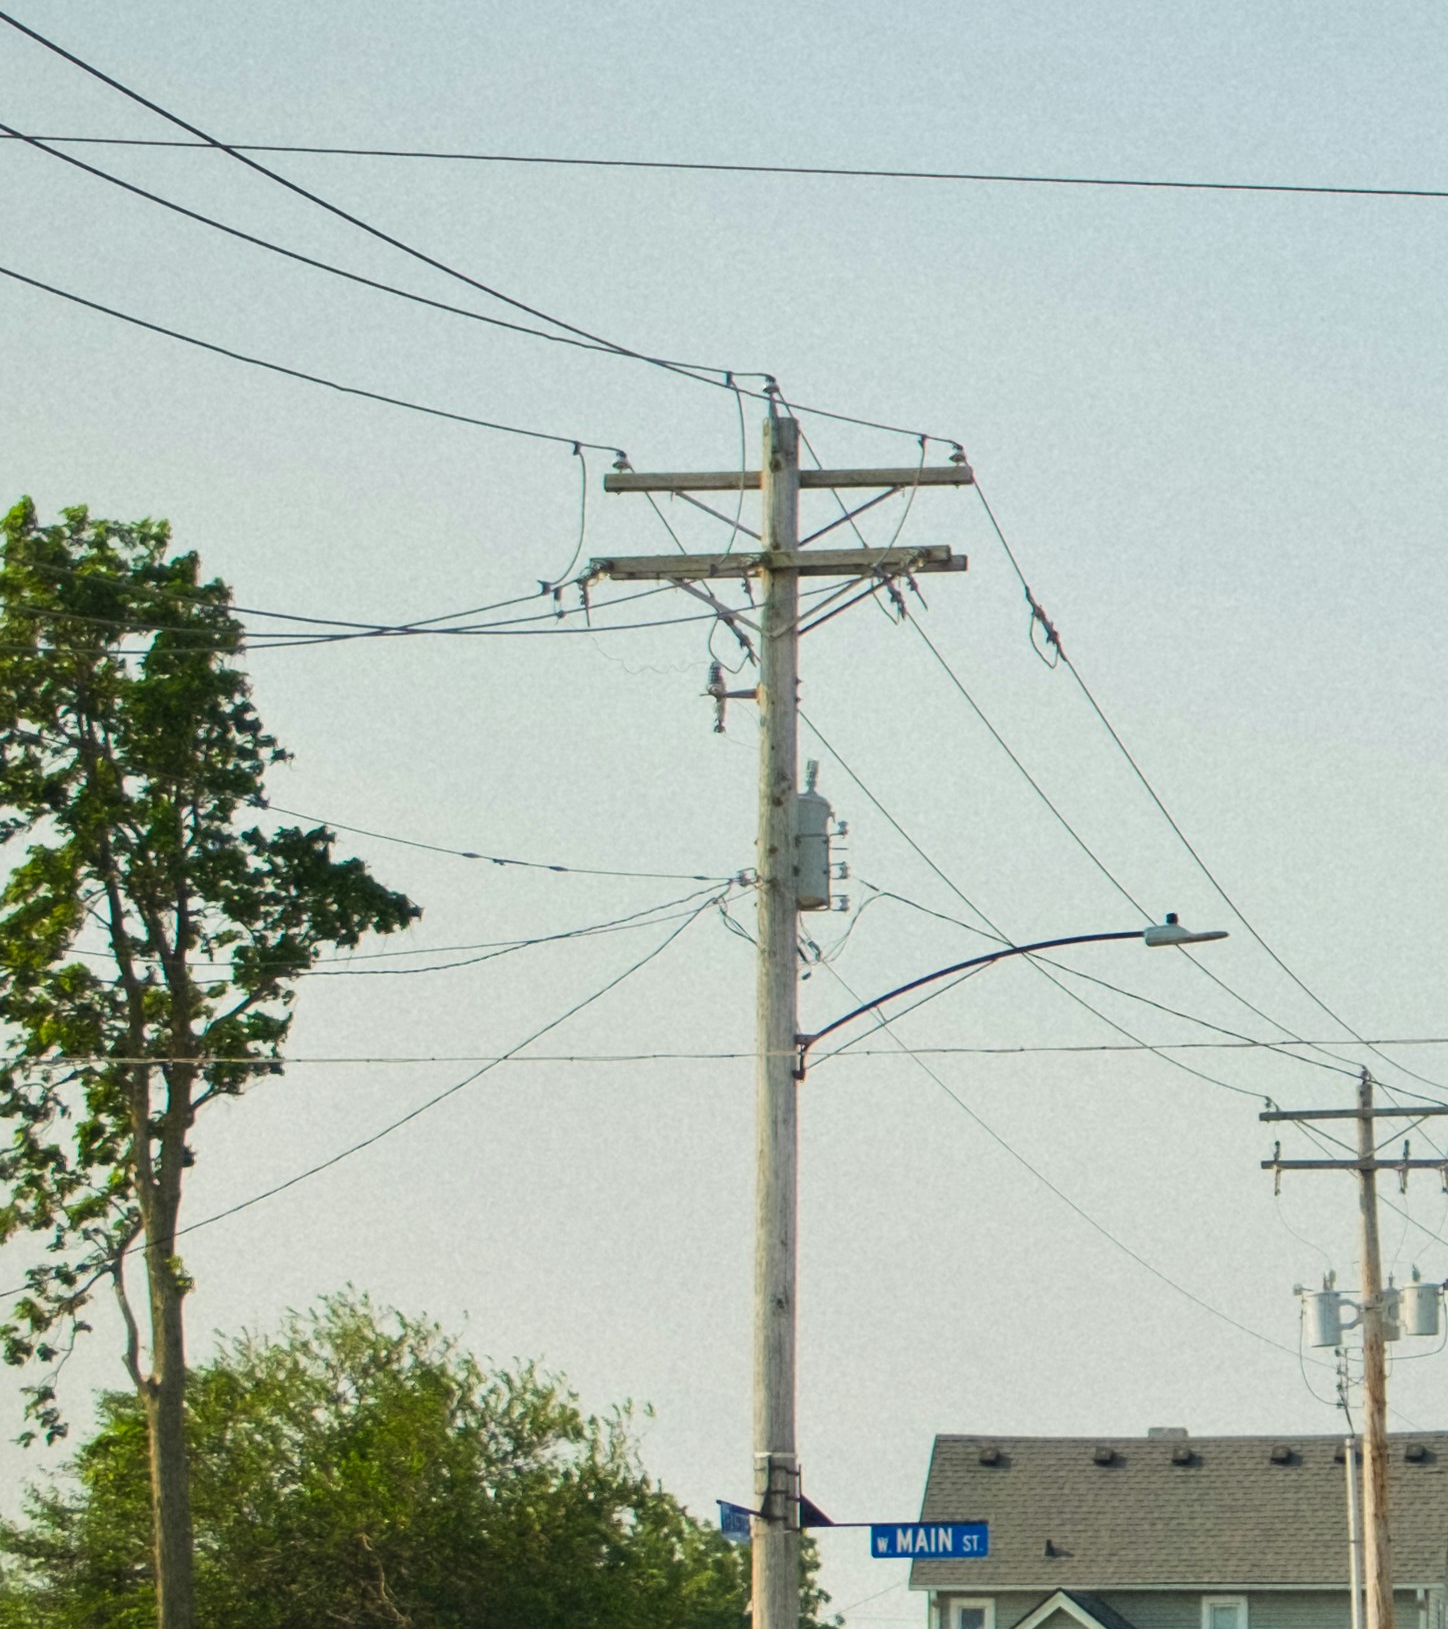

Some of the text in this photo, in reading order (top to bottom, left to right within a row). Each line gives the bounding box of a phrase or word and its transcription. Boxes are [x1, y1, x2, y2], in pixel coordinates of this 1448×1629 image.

[877, 1528, 984, 1553] W. MAIN ST.
